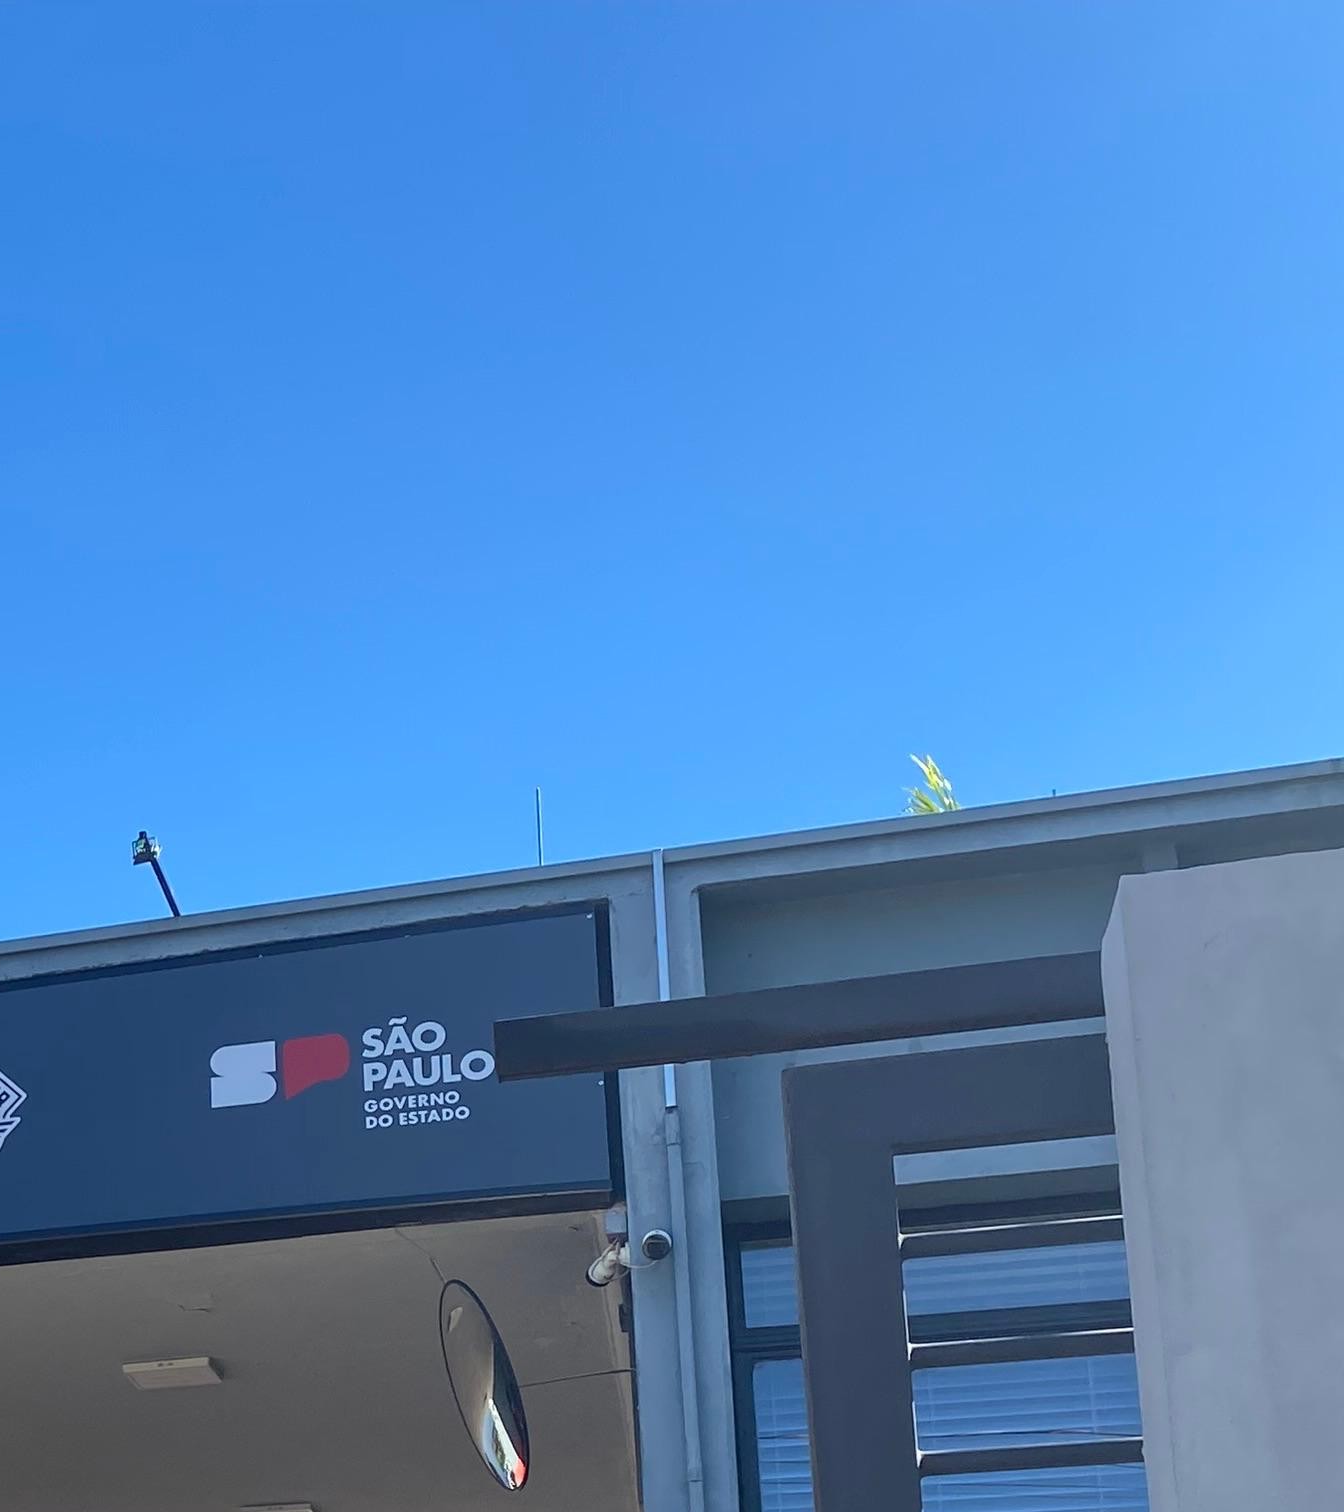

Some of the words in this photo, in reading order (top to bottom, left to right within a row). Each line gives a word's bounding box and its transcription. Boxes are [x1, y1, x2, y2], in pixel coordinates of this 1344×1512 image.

[362, 1016, 446, 1058] SÃO
[363, 1050, 496, 1092] PAULO
[364, 1091, 460, 1113] GOVERNO
[365, 1115, 393, 1129] DO
[399, 1106, 470, 1126] ESTADO
